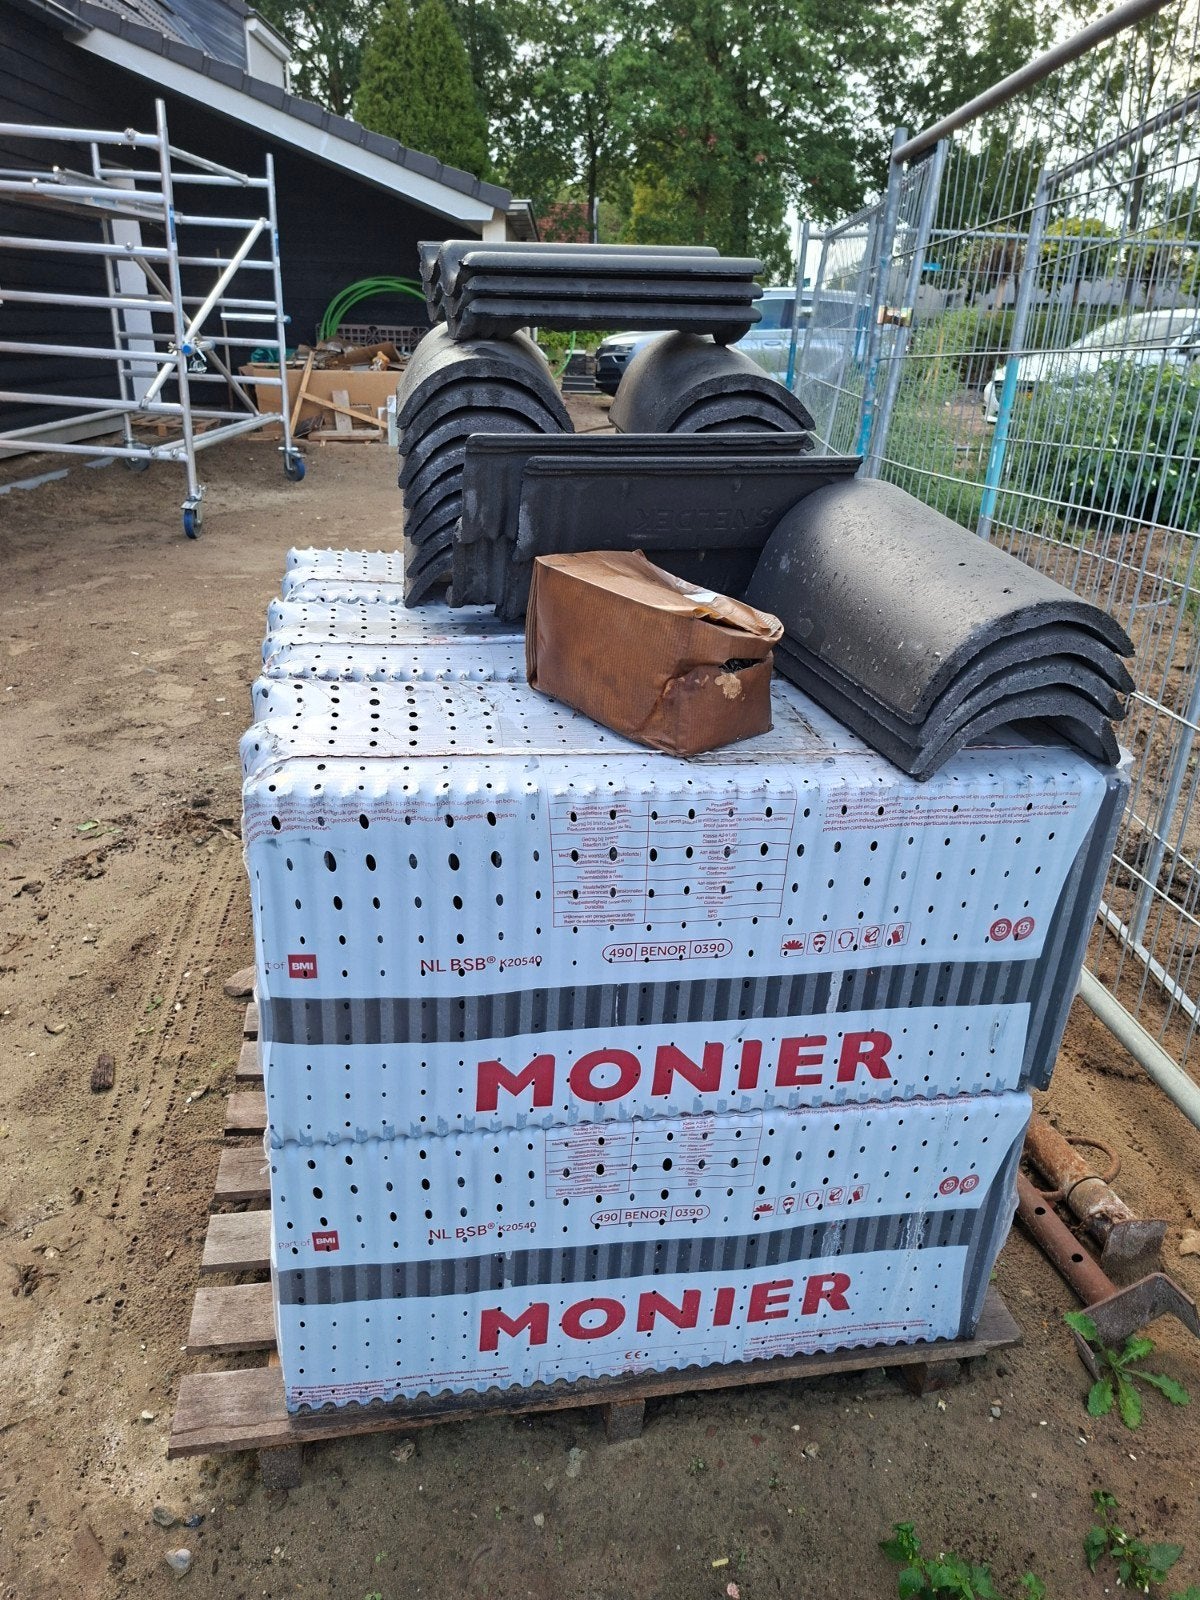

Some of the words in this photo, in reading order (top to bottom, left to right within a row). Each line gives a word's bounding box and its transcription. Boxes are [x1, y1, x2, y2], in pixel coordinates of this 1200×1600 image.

[609, 947, 633, 958] 490
[641, 944, 687, 957] BENOR
[694, 942, 725, 955] 0390
[291, 962, 314, 971] BMI
[420, 959, 446, 972] NL
[500, 955, 543, 968] K20540
[475, 1030, 893, 1112] MONIER
[597, 1213, 618, 1222] 490
[625, 1209, 667, 1220] BENOR
[675, 1208, 703, 1217] 0390
[429, 1229, 452, 1240] NL
[498, 1221, 537, 1232] K20540
[315, 1237, 336, 1245] BMI
[479, 1272, 852, 1352] MONIER
